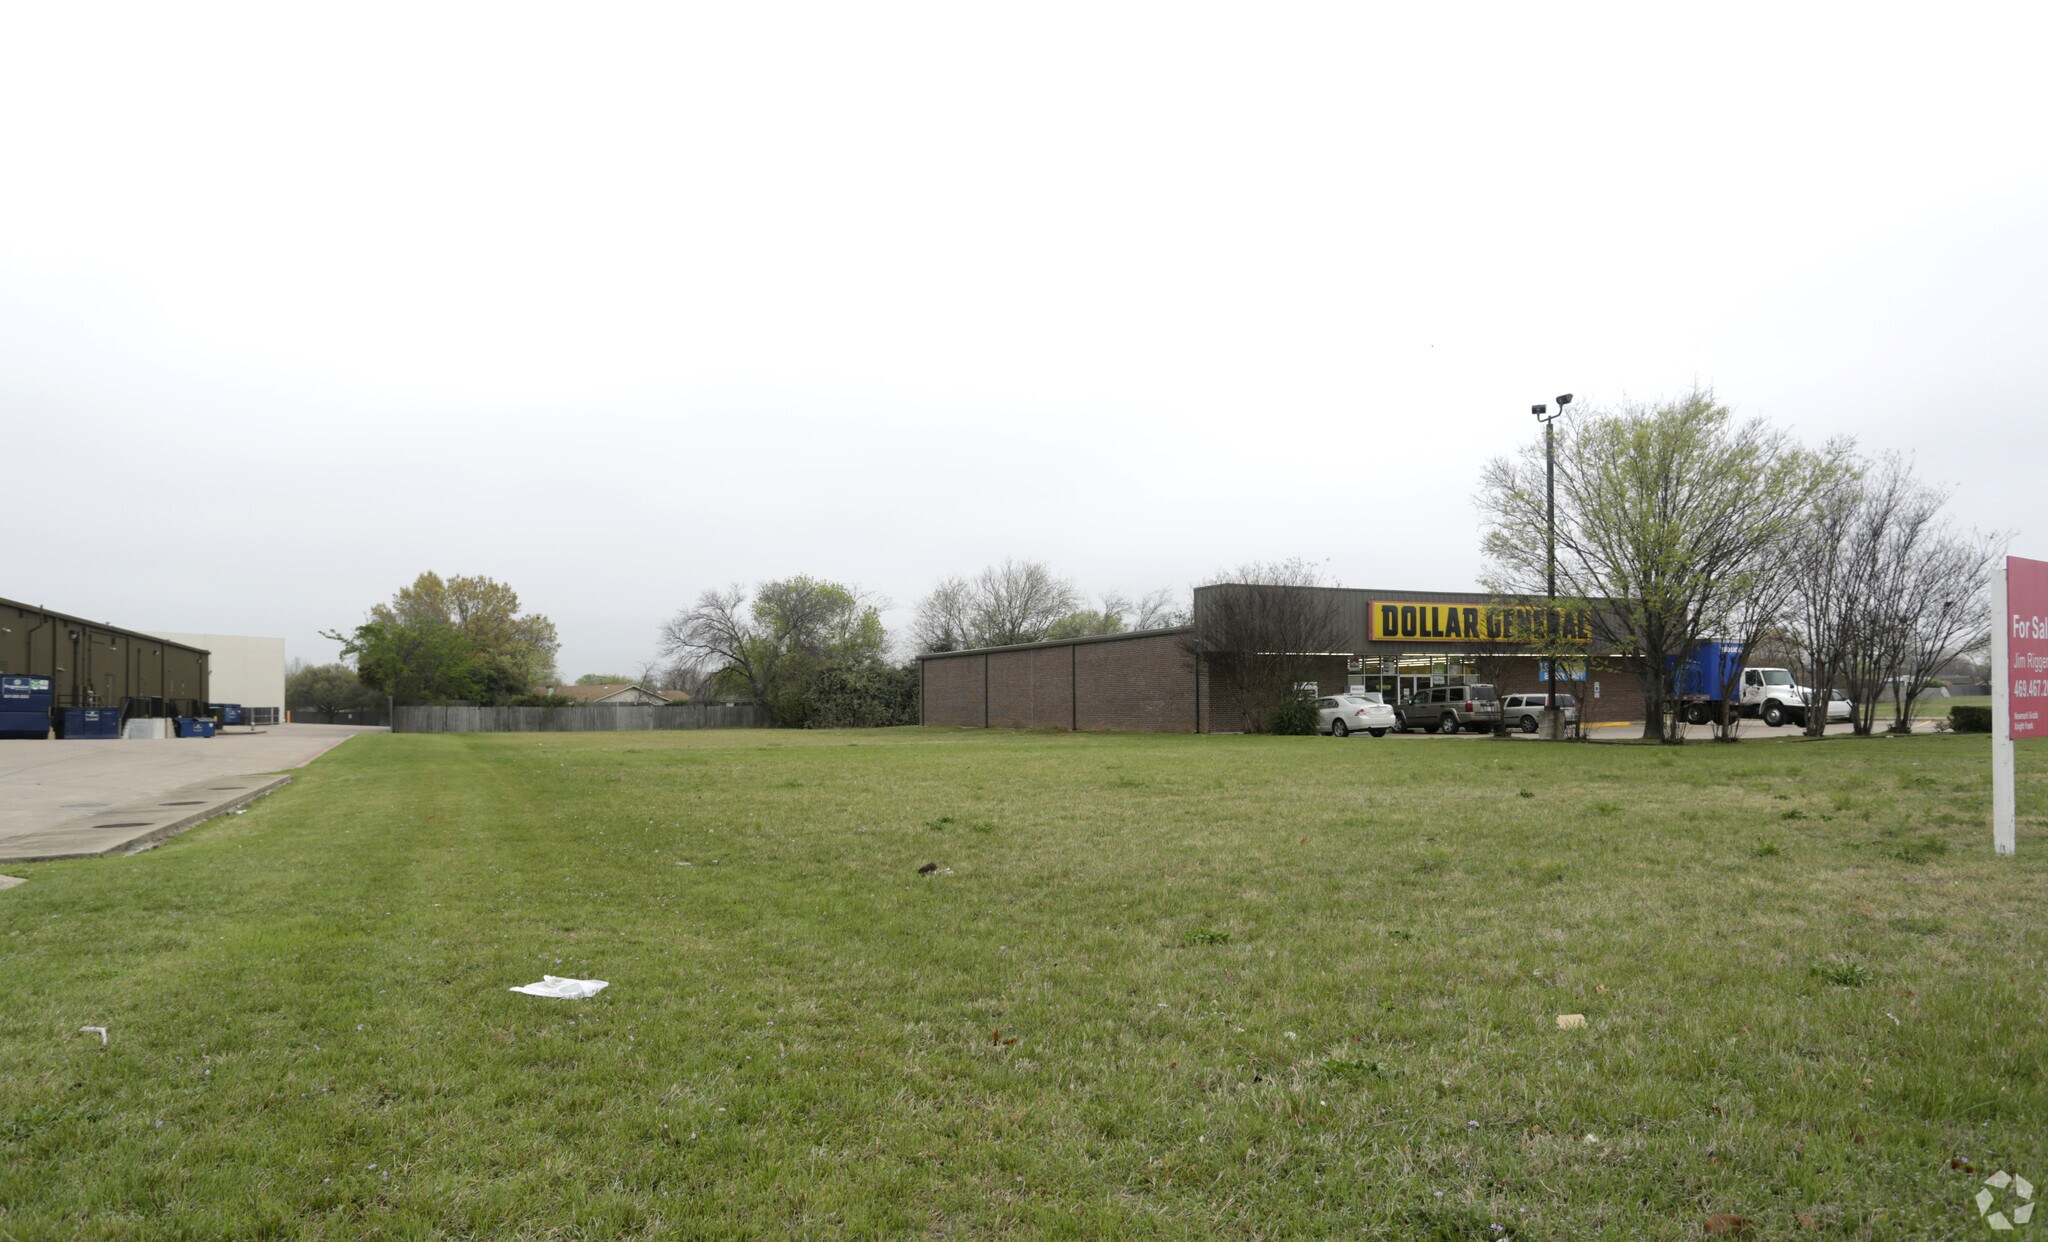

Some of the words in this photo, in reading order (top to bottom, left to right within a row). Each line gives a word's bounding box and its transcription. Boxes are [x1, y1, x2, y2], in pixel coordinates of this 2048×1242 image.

[1382, 604, 1479, 638] DOLLAR
[2013, 614, 2030, 639] For
[2032, 616, 2048, 640] Sal
[2014, 653, 2025, 668] Jim
